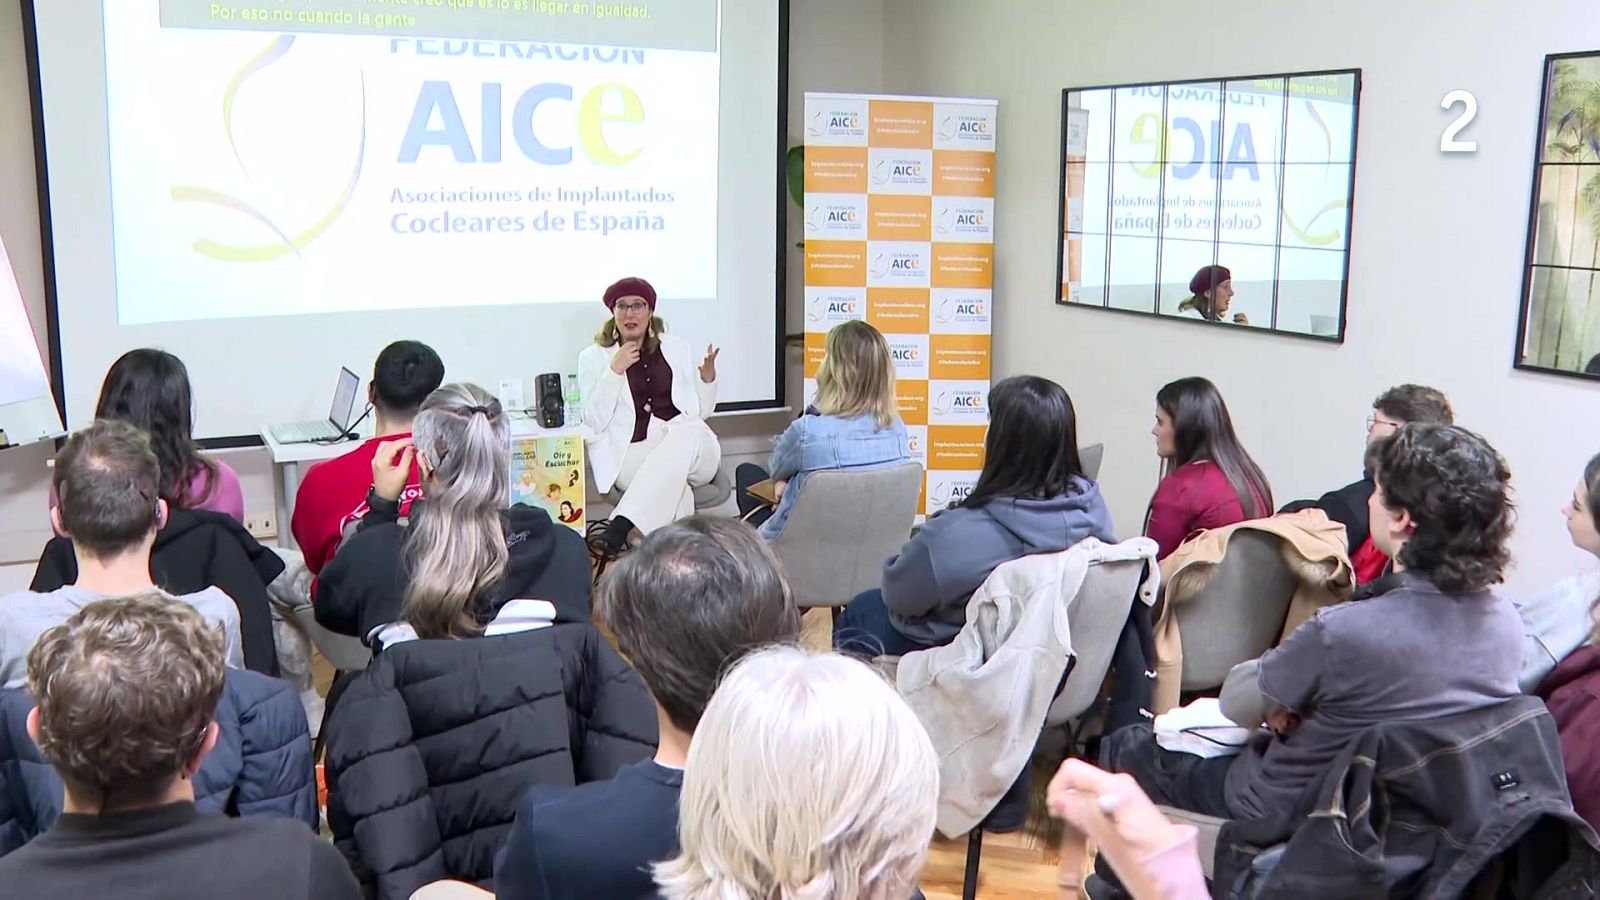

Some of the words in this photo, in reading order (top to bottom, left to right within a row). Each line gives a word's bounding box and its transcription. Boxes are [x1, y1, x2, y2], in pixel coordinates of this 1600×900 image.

[532, 0, 570, 18] llegar
[573, 3, 589, 15] en
[592, 2, 651, 19] igualdad.
[210, 4, 237, 20] Por
[241, 8, 269, 21] eso
[273, 9, 293, 22] no
[298, 8, 353, 24] cuando
[358, 11, 371, 25] la
[374, 13, 417, 29] gente
[396, 79, 645, 167] AICe
[830, 117, 858, 128] AICe
[960, 122, 986, 133] AICe
[893, 166, 921, 176] AICe
[390, 187, 522, 204] Asociaciones
[528, 187, 551, 203] de
[557, 186, 675, 206] Implantados
[828, 211, 856, 222] AICe
[957, 214, 983, 225] AICe
[390, 211, 525, 234] Cocleares
[533, 210, 565, 232] de
[573, 210, 665, 236] España
[892, 259, 919, 269] AICe
[828, 302, 856, 312] AICe
[956, 304, 983, 315] AICe
[954, 396, 981, 407] AICe
[952, 487, 971, 497] AIC
